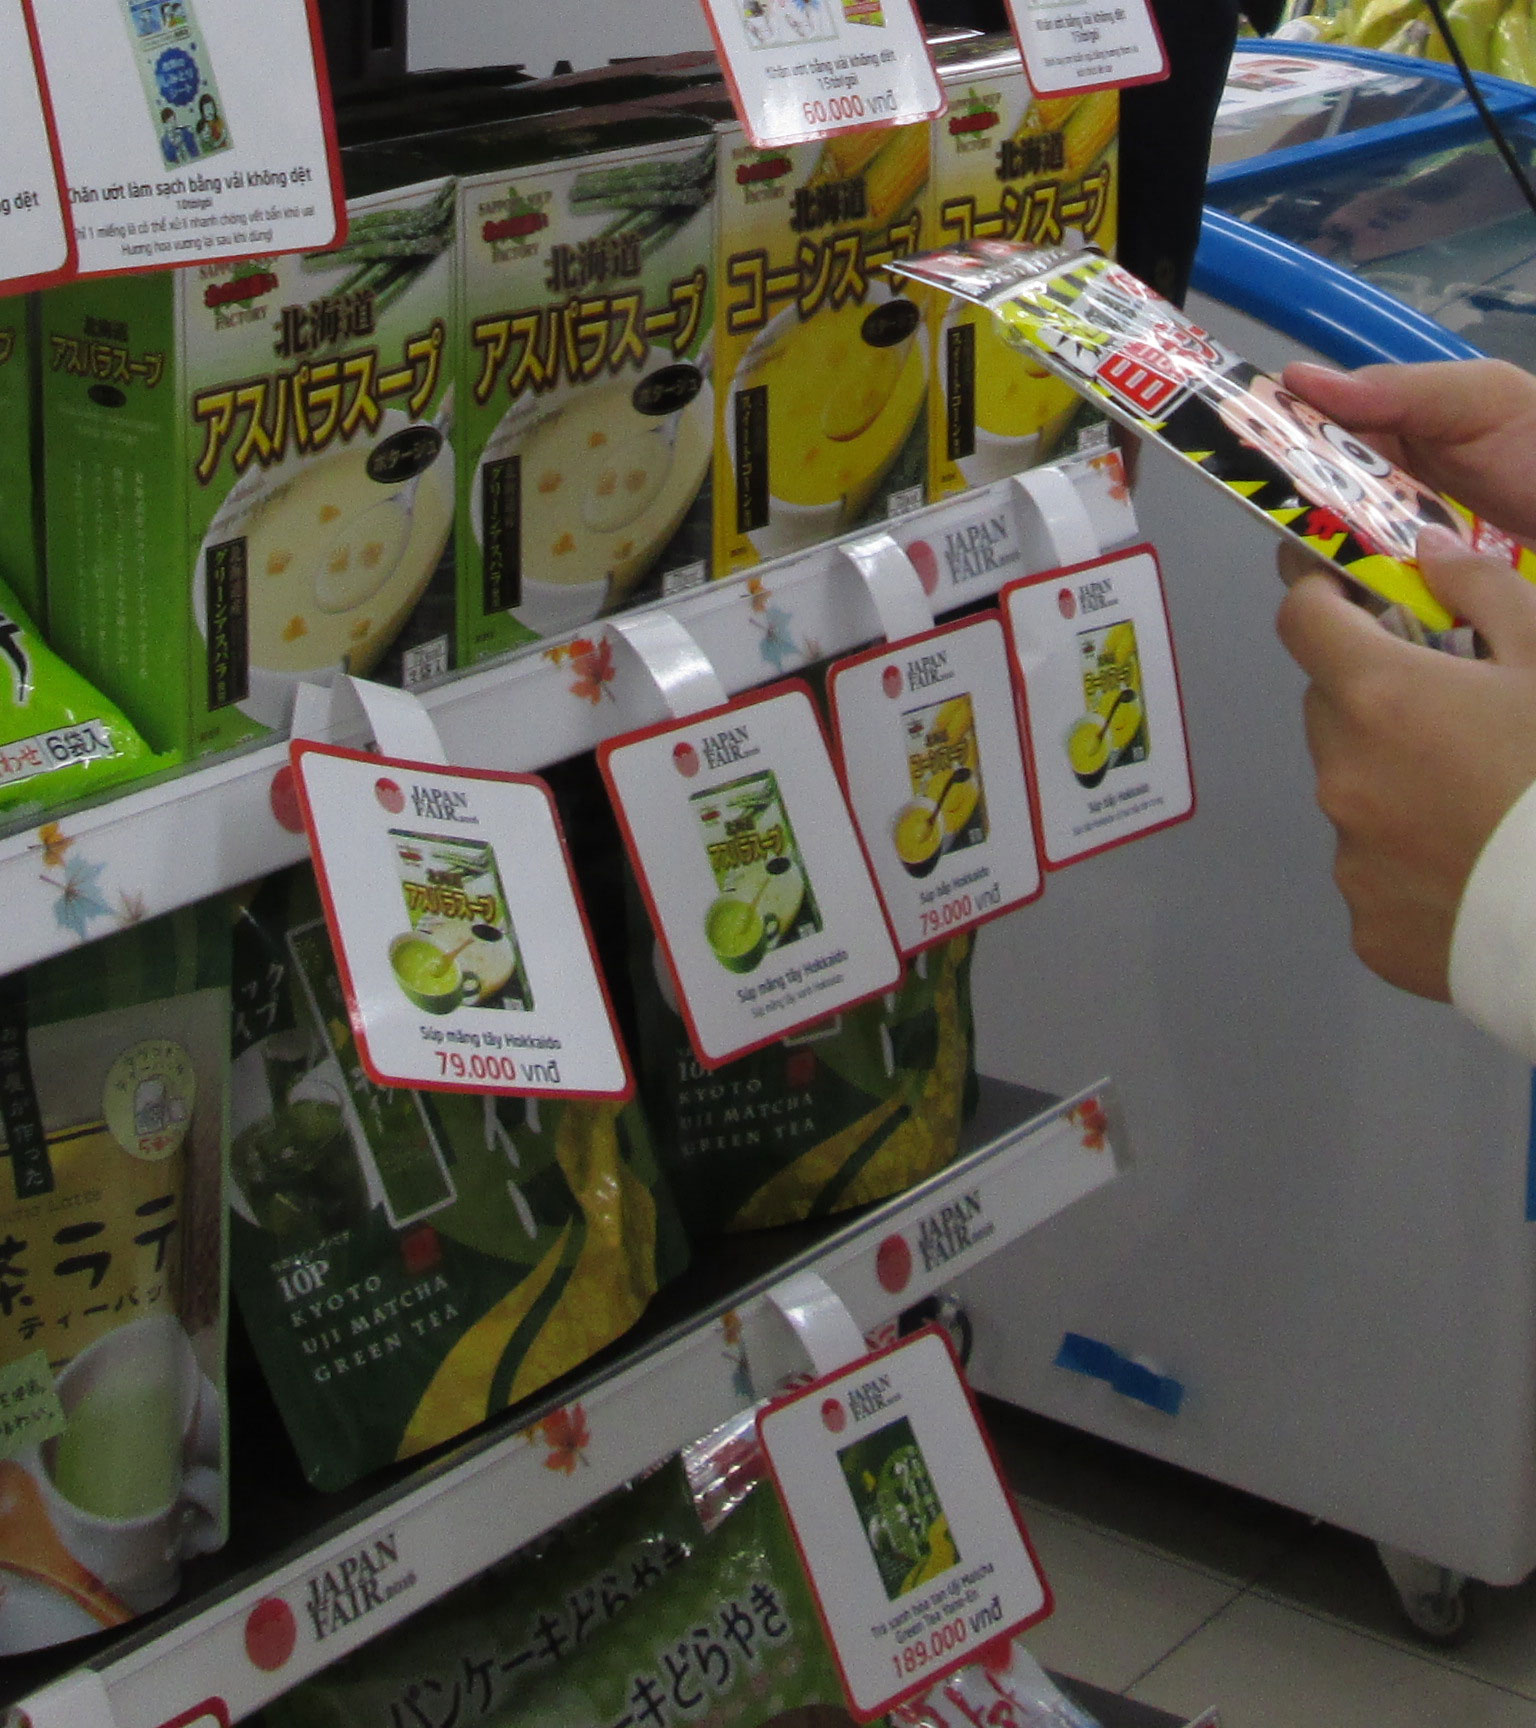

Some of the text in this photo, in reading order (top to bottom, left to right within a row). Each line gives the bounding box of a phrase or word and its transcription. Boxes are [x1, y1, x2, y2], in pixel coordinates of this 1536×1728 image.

[802, 94, 864, 125] 60.000
[13, 190, 40, 216] dệt
[128, 181, 153, 198] làm
[156, 178, 187, 199] sạch
[188, 173, 222, 194] bằng
[224, 172, 244, 189] vải
[247, 168, 287, 187] không
[290, 165, 313, 186] dệt
[726, 210, 923, 336] コーンスープ
[272, 288, 378, 359] 北海道
[472, 264, 708, 406] アスパラスープ
[192, 317, 447, 485] アスパラスープ
[943, 515, 1010, 556] JAPAN
[949, 544, 1002, 585] FAIR
[907, 650, 949, 678] JAPAN
[48, 720, 115, 763] 6袋入
[702, 724, 750, 754] JAPAN
[411, 784, 469, 810] JAPAN
[415, 803, 458, 823] FAIR
[918, 894, 973, 936] 79.000
[434, 1050, 561, 1084] 79.000 vnđ
[916, 1191, 983, 1243] JAPAN
[920, 1223, 974, 1272] FAIR
[290, 1275, 383, 1329] KYOTO
[350, 1274, 449, 1336] MATCHA
[314, 1303, 460, 1382] GREEN TEA
[305, 1533, 401, 1607] JAPAN
[310, 1576, 385, 1643] FAIR
[892, 1594, 1003, 1679] 189.000 vnđ
